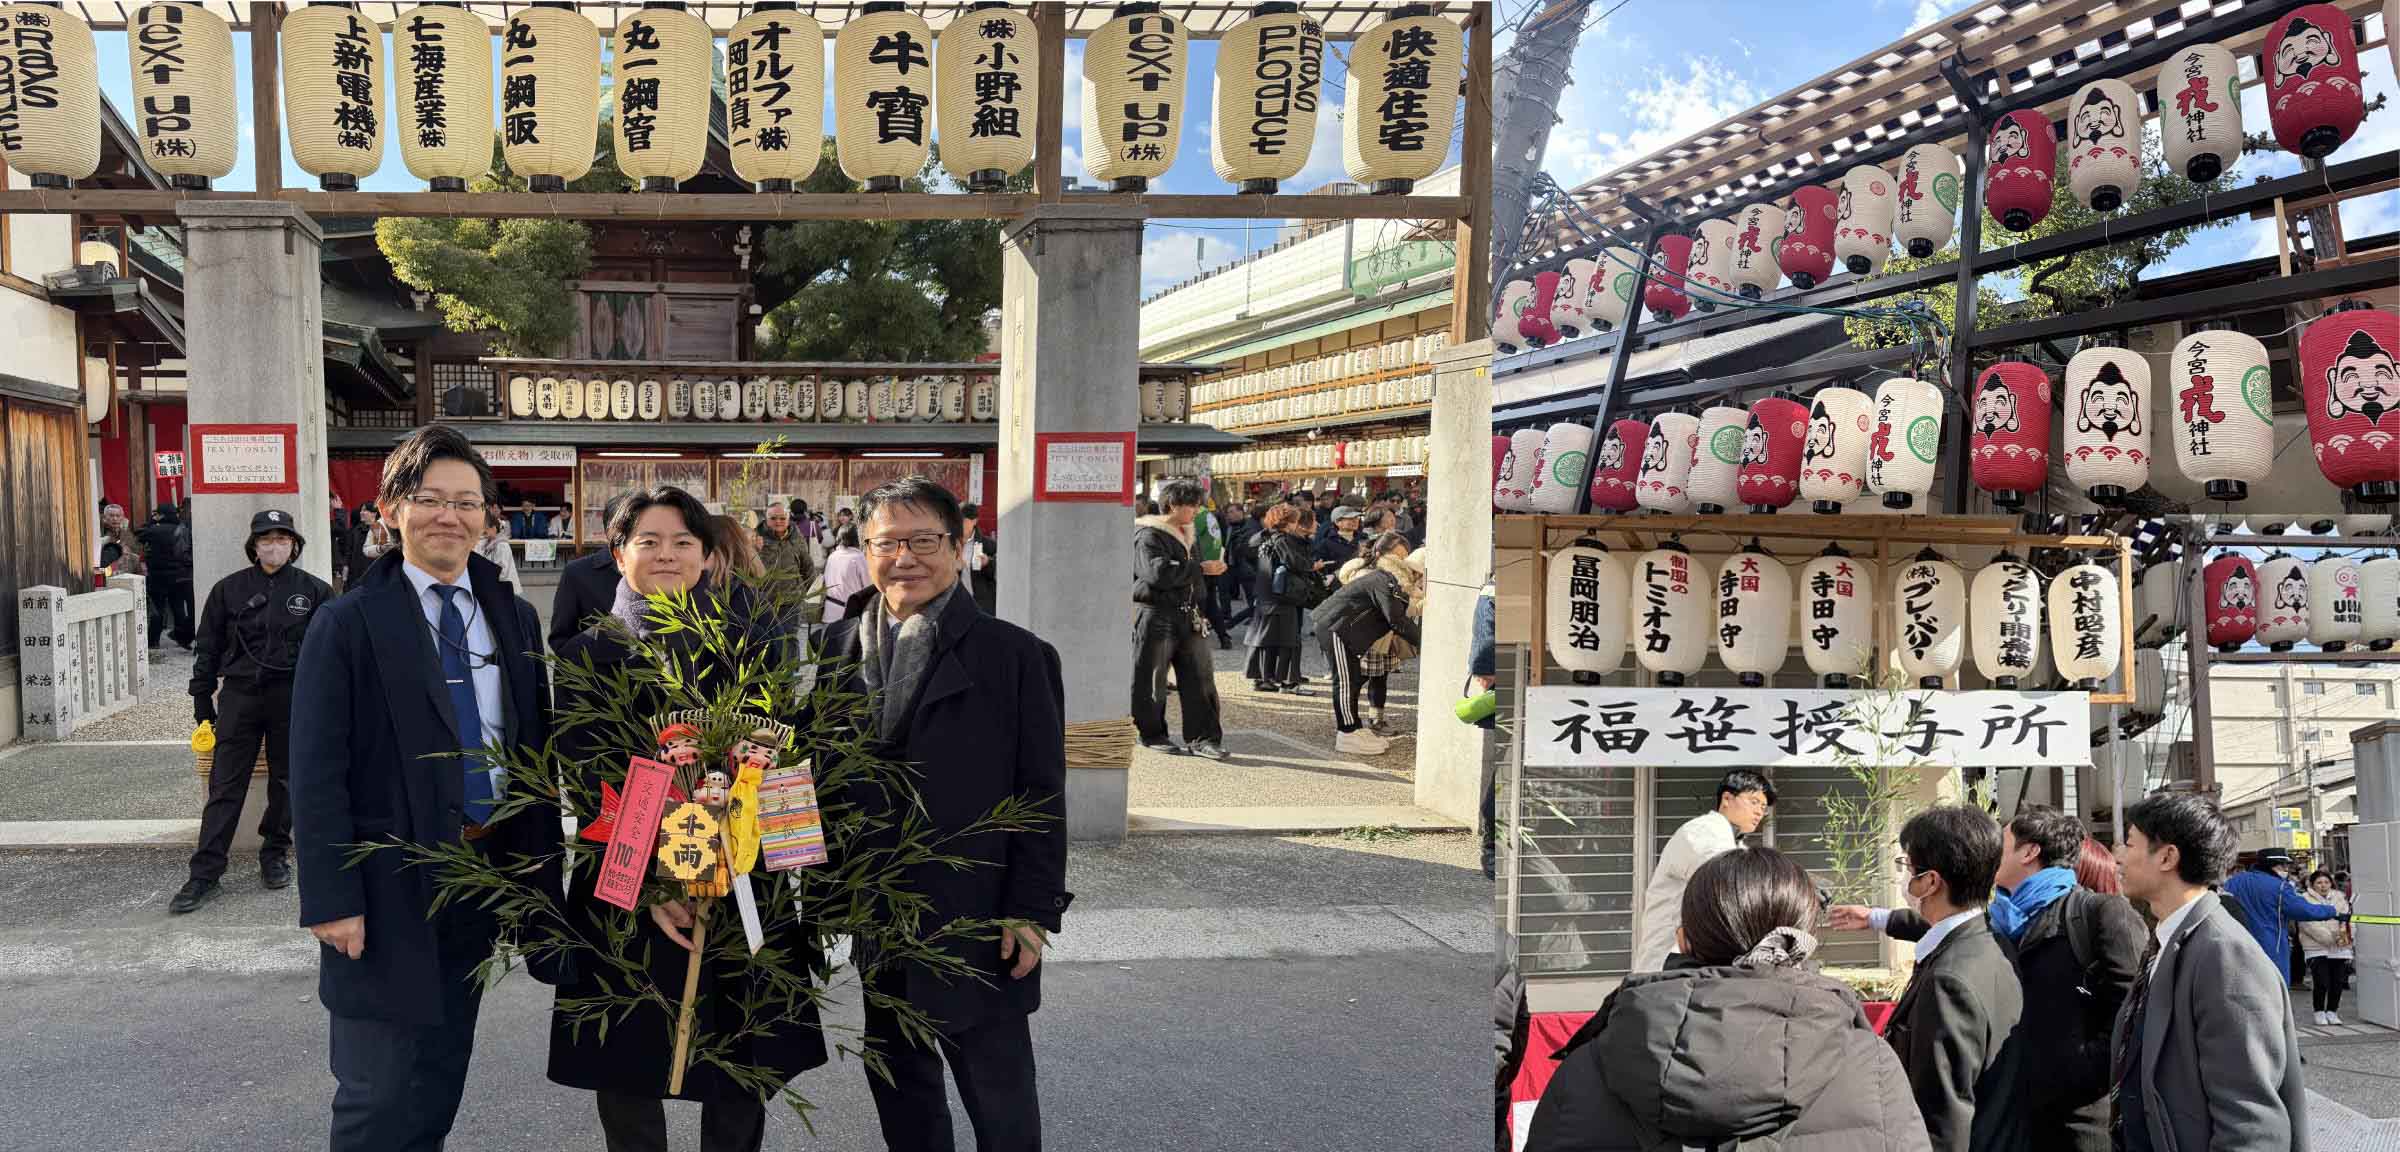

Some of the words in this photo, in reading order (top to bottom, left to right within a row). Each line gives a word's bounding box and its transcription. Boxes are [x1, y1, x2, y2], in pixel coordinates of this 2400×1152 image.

[407, 15, 447, 149] 七海産業(株)
[503, 17, 540, 147] 丸一鋼販
[621, 19, 661, 153] 丸一鋼管
[1376, 26, 1438, 152] 快適住宅
[2175, 52, 2219, 143] 今宮戎神社
[1869, 394, 1896, 487] 今宮戎神社
[2179, 340, 2227, 457] 今宮戎神社
[1642, 561, 1672, 653] トミオカ
[1669, 554, 1689, 594] 制服の
[1719, 569, 1743, 648] 寺田守
[1740, 558, 1760, 592] 大国
[1810, 571, 1839, 650] 寺田守
[1835, 562, 1853, 597] 大国
[2069, 571, 2104, 661] 中村昭彦
[1551, 697, 2068, 758] 福笹授与所
